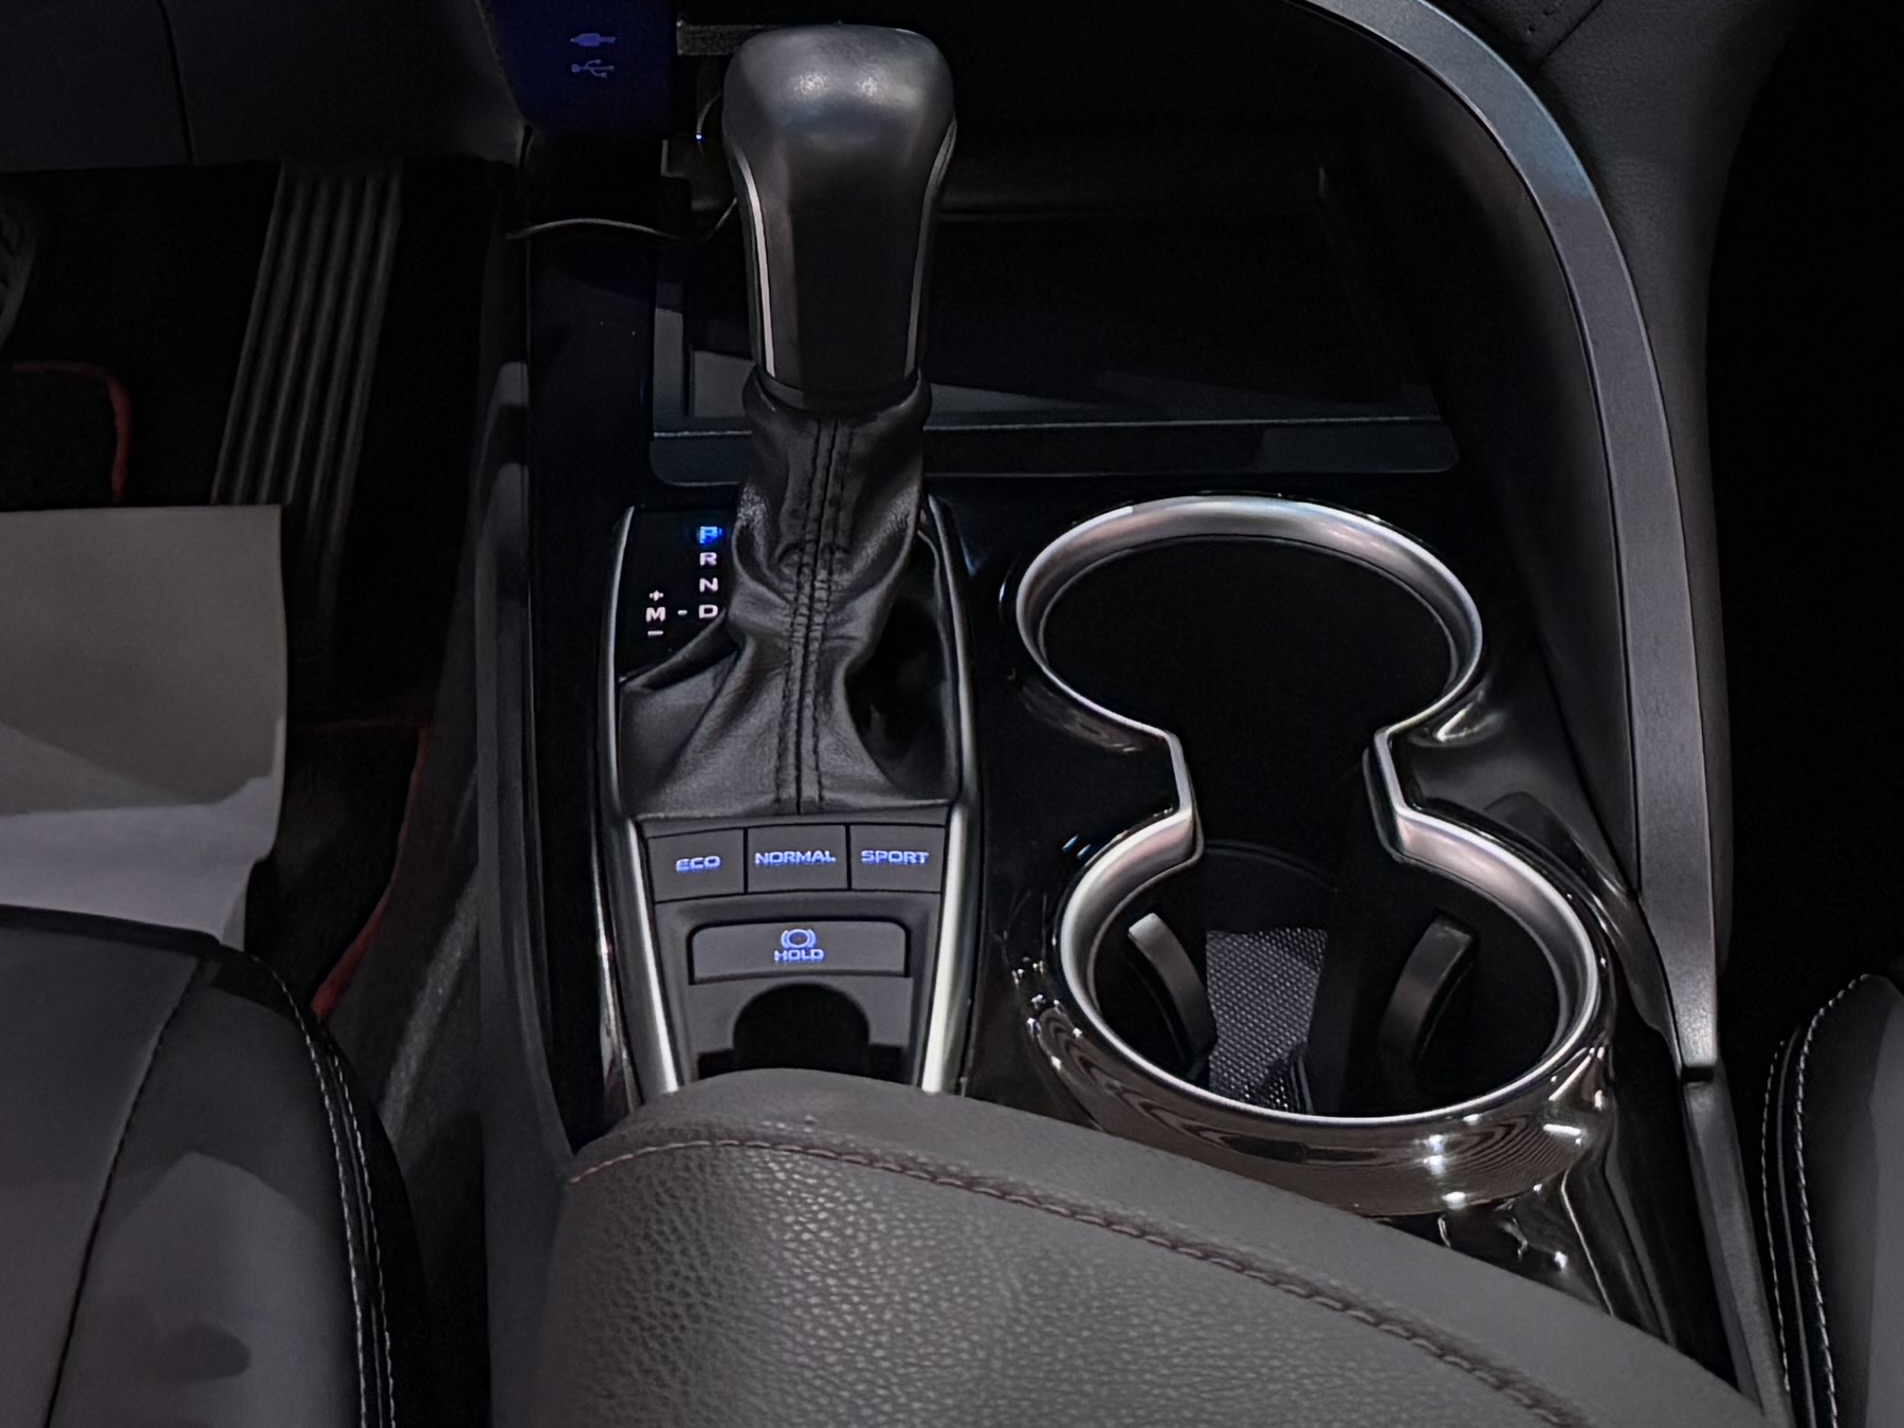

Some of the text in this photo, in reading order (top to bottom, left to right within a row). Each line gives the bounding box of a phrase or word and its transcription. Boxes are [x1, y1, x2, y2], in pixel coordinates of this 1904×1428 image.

[699, 527, 722, 545] P
[700, 552, 717, 565] R
[700, 578, 718, 592] N
[645, 605, 666, 623] M
[699, 605, 718, 618] D
[676, 856, 720, 872] ECO
[755, 851, 836, 865] NORMAL
[862, 851, 928, 864] SPORT
[773, 946, 825, 963] HOLD
